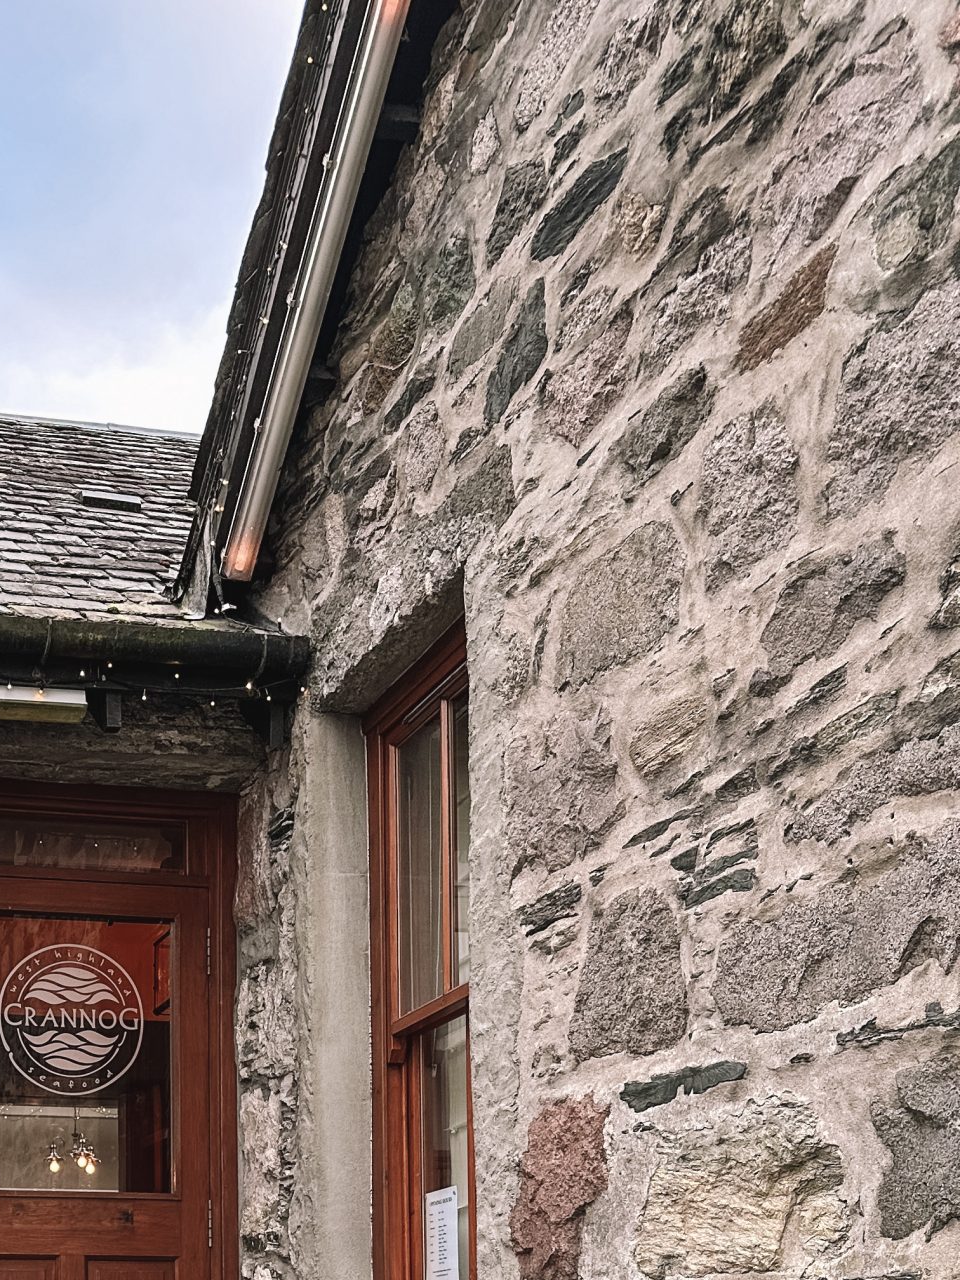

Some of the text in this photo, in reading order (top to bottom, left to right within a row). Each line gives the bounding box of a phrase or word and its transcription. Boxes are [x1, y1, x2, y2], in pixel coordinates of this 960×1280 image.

[10, 950, 133, 997] west highland
[3, 1003, 139, 1031] CRANNOG
[28, 1067, 114, 1089] seafood
